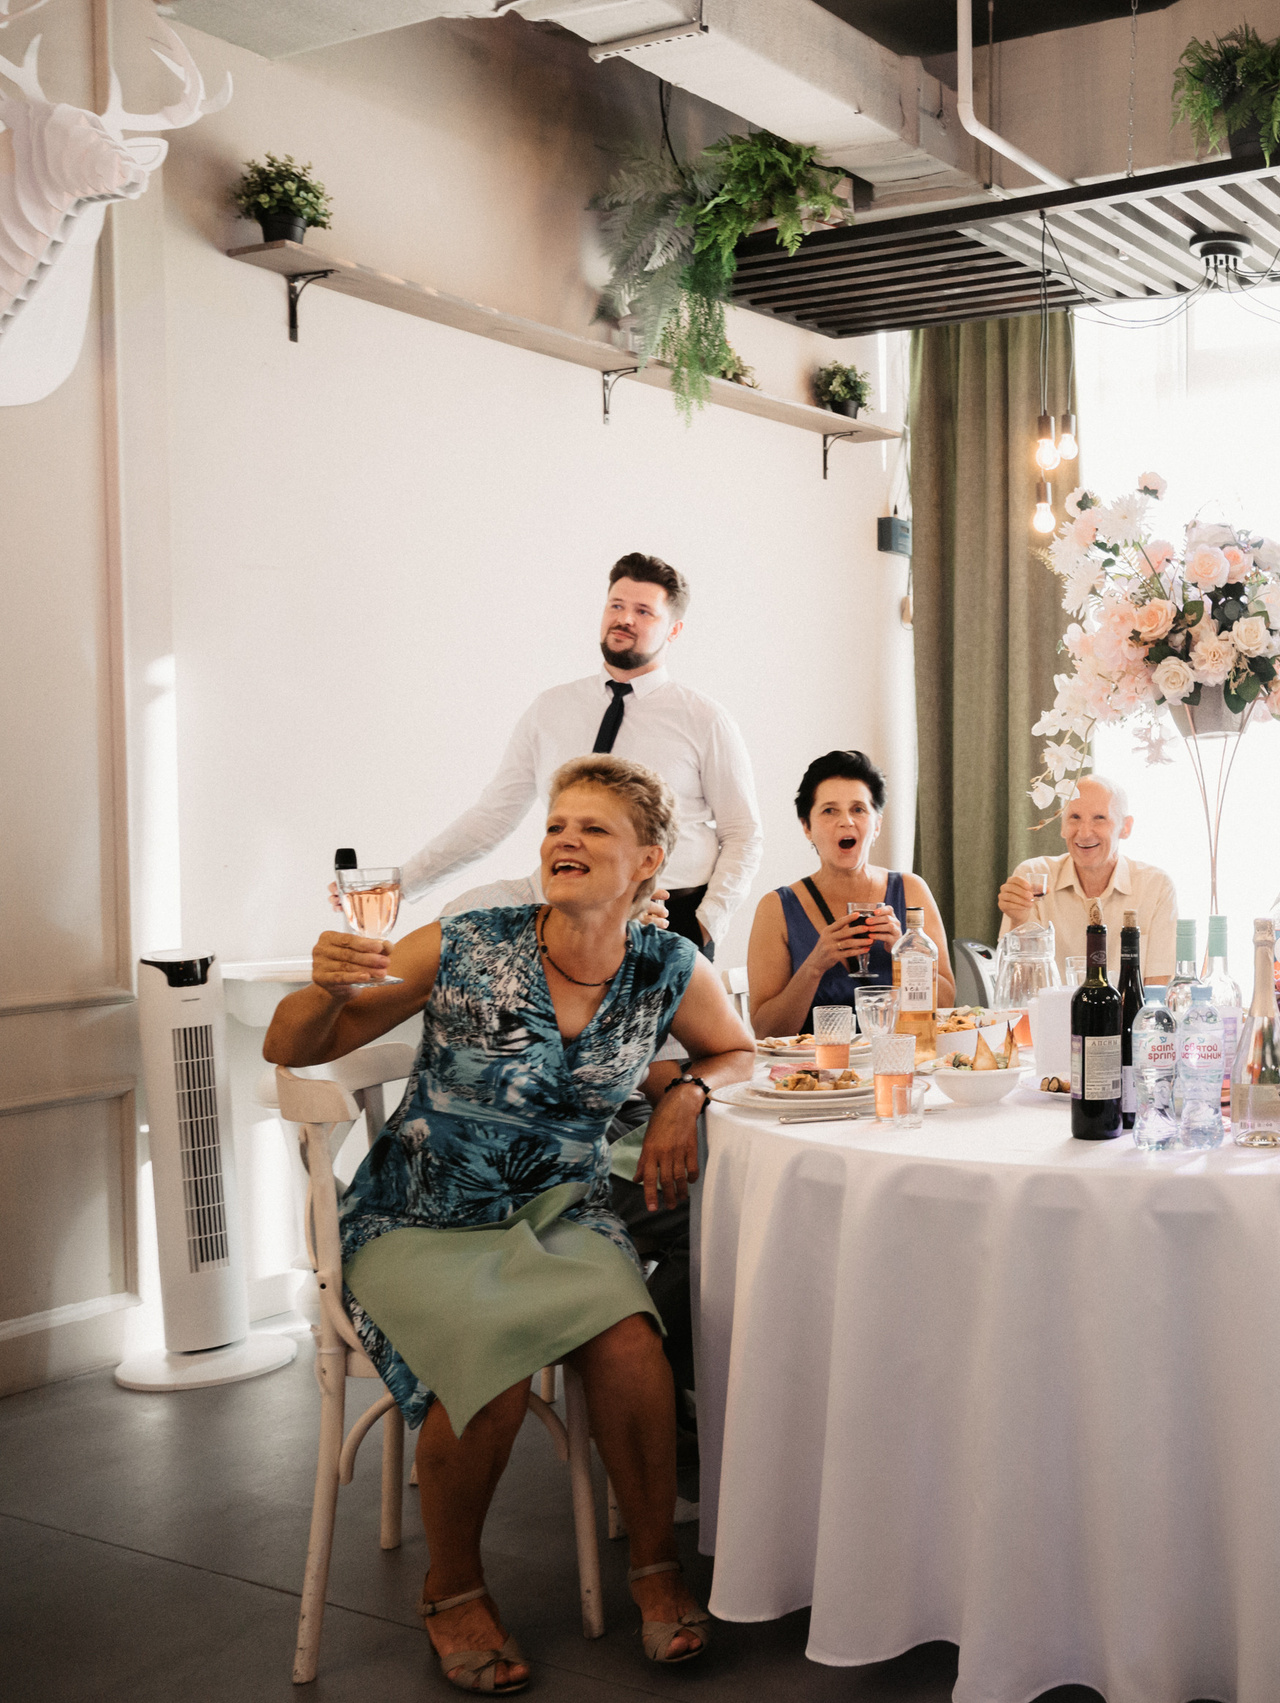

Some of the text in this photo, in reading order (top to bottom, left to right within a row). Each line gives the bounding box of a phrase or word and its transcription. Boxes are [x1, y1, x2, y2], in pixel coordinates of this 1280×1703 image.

[1151, 1043, 1174, 1052] saint
[1184, 1042, 1218, 1052] святой
[1148, 1051, 1176, 1062] spring
